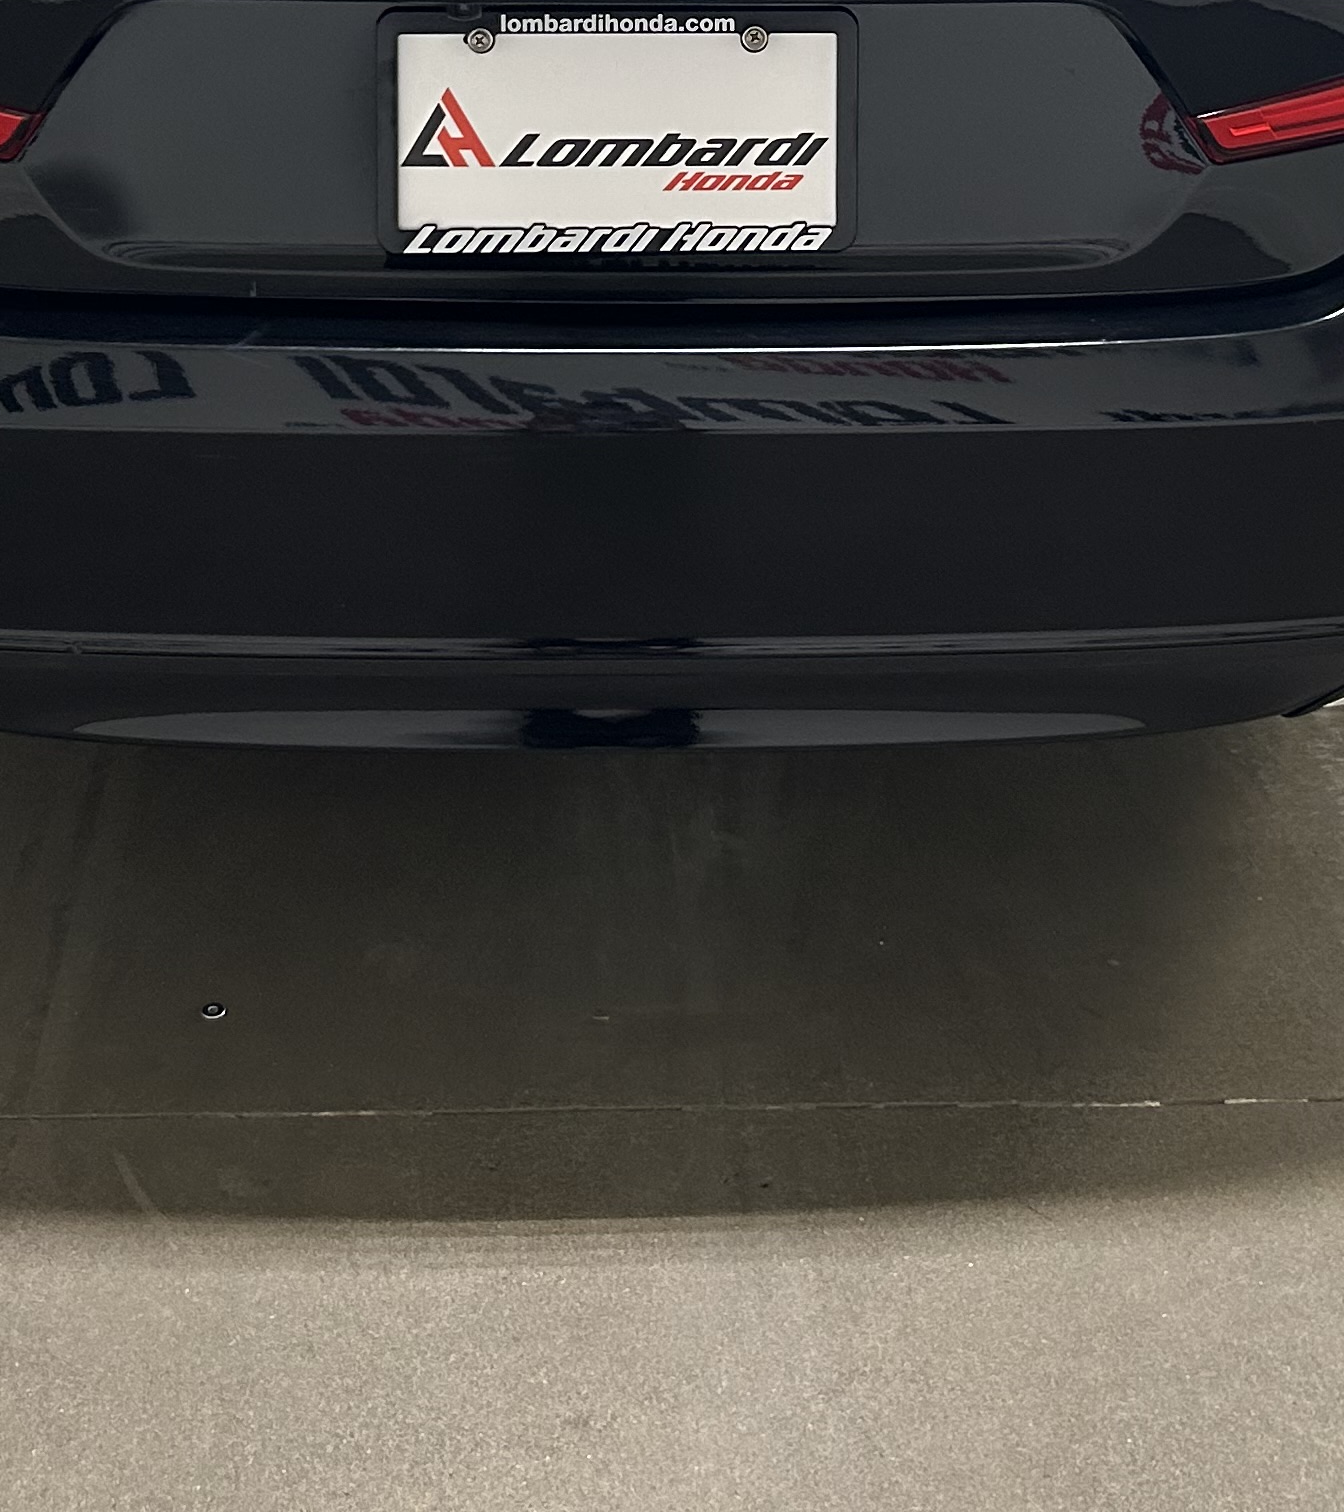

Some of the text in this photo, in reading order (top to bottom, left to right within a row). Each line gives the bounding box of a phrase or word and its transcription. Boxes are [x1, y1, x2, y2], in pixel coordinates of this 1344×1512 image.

[500, 14, 736, 33] lombardihonda.com
[499, 132, 830, 167] Lombardi
[663, 171, 804, 191] Honda
[403, 222, 833, 254] Lombardi Honda
